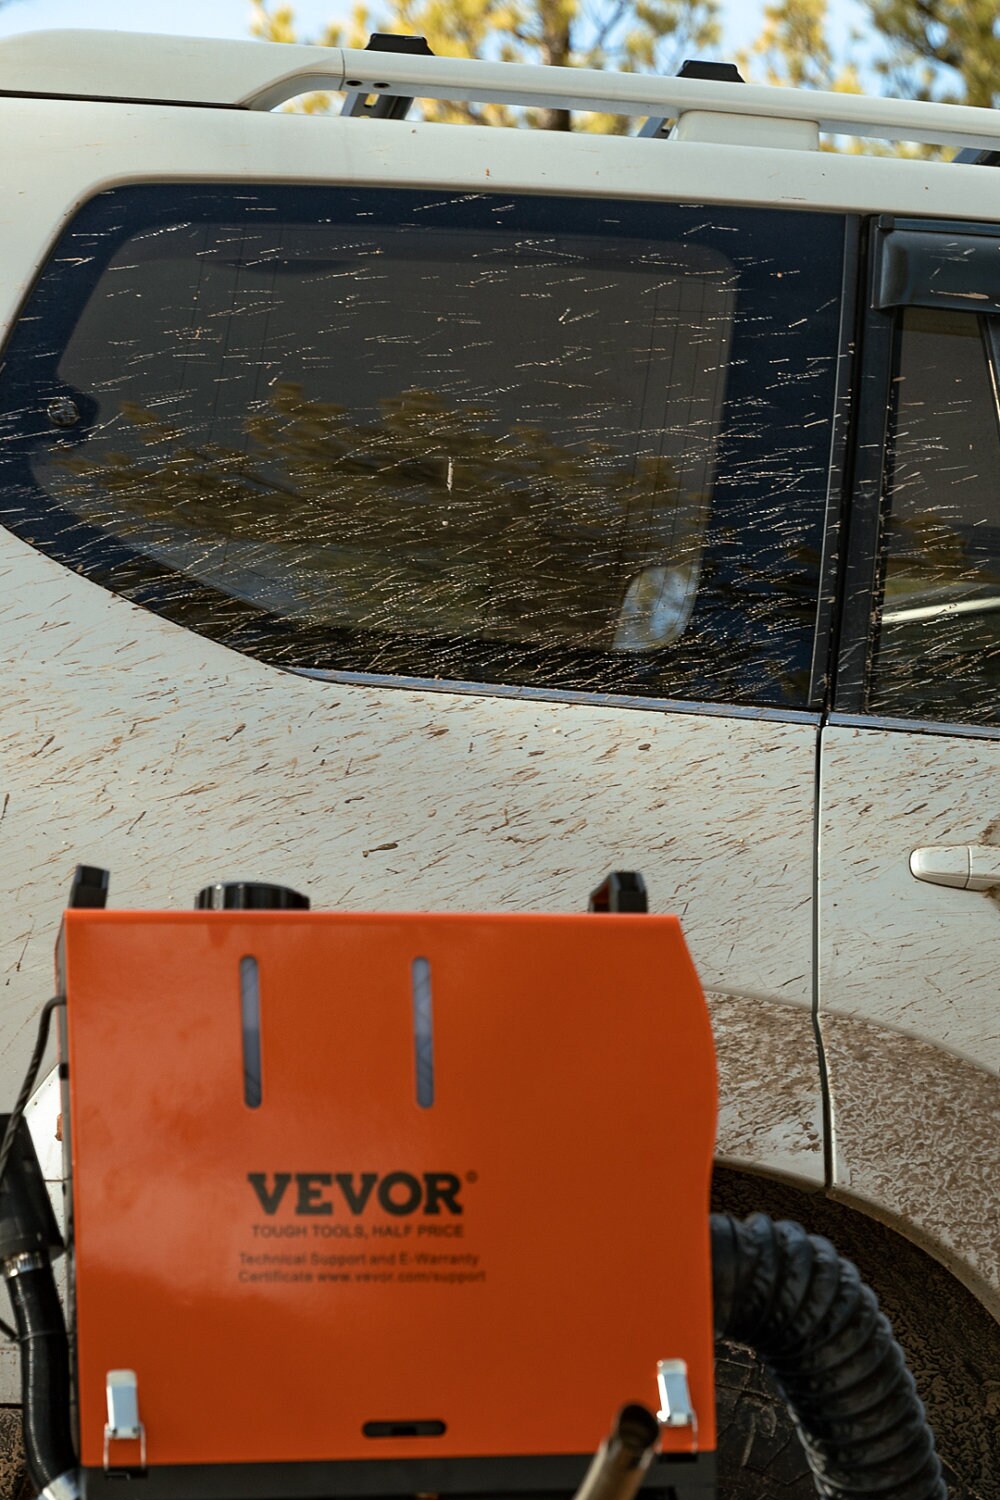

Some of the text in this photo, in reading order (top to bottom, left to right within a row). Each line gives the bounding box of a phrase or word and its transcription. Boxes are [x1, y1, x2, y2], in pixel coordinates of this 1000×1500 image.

[247, 1171, 463, 1217] VEVOR
[252, 1225, 464, 1240] TOUGH TOOLS, HALF PRICE
[240, 1253, 306, 1266] Technical
[311, 1253, 365, 1268] Support
[370, 1254, 395, 1266] and
[238, 1271, 313, 1284] Certificate
